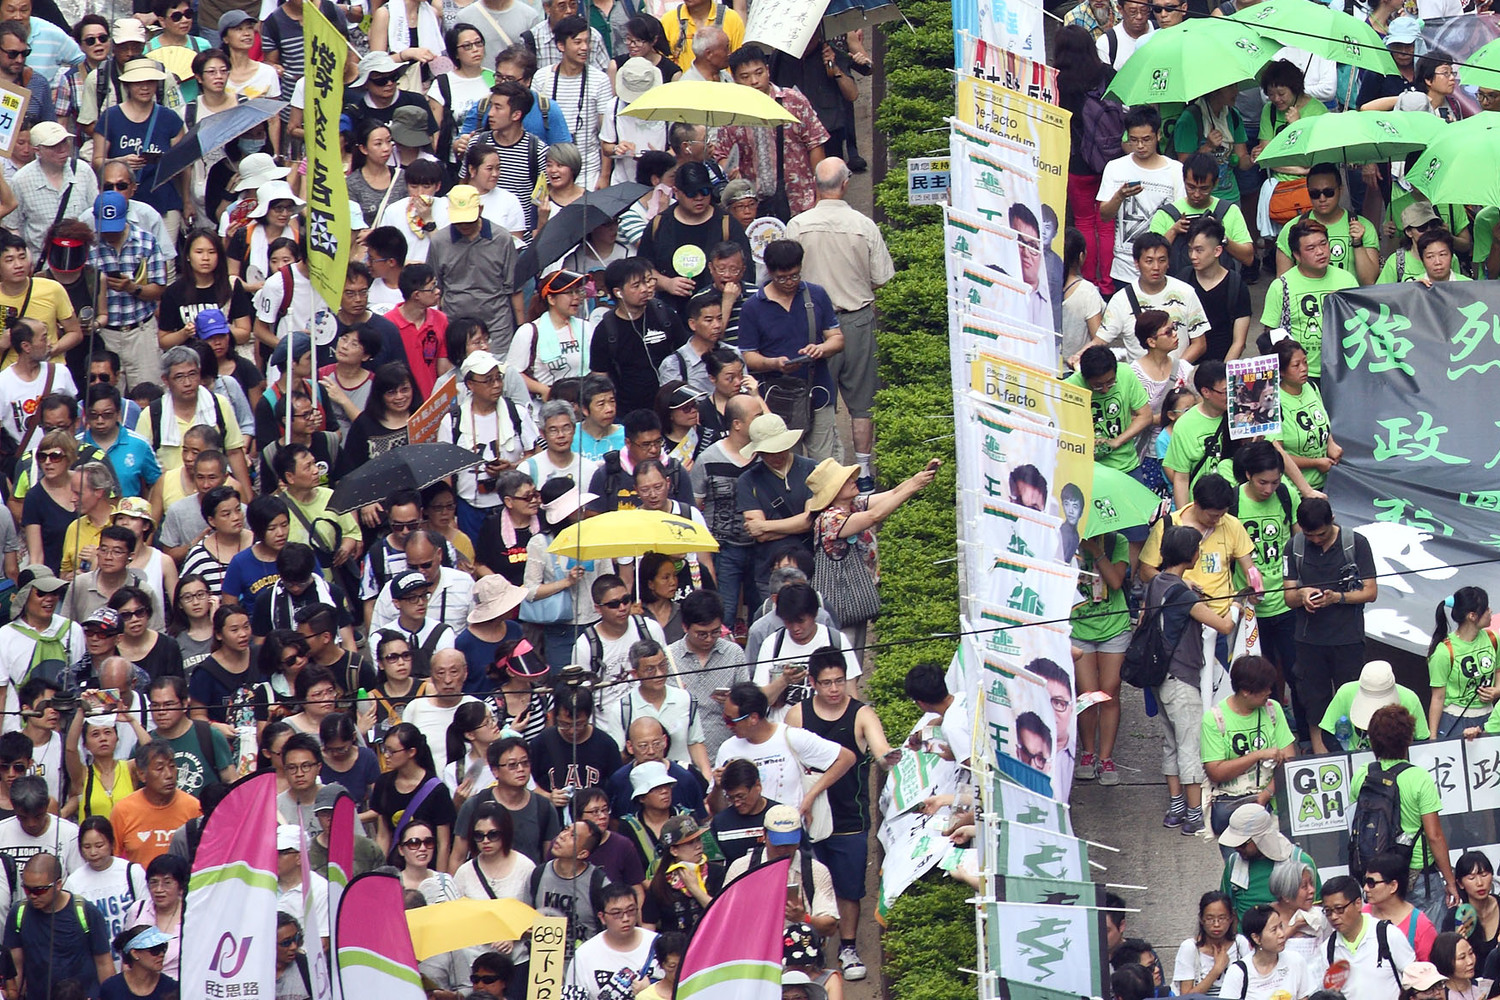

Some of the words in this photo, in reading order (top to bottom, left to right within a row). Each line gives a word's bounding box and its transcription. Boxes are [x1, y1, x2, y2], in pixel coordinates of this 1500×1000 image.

[119, 134, 142, 153] Gap
[1032, 155, 1062, 178] tional
[1056, 438, 1086, 456] ional
[534, 926, 563, 945] 689
